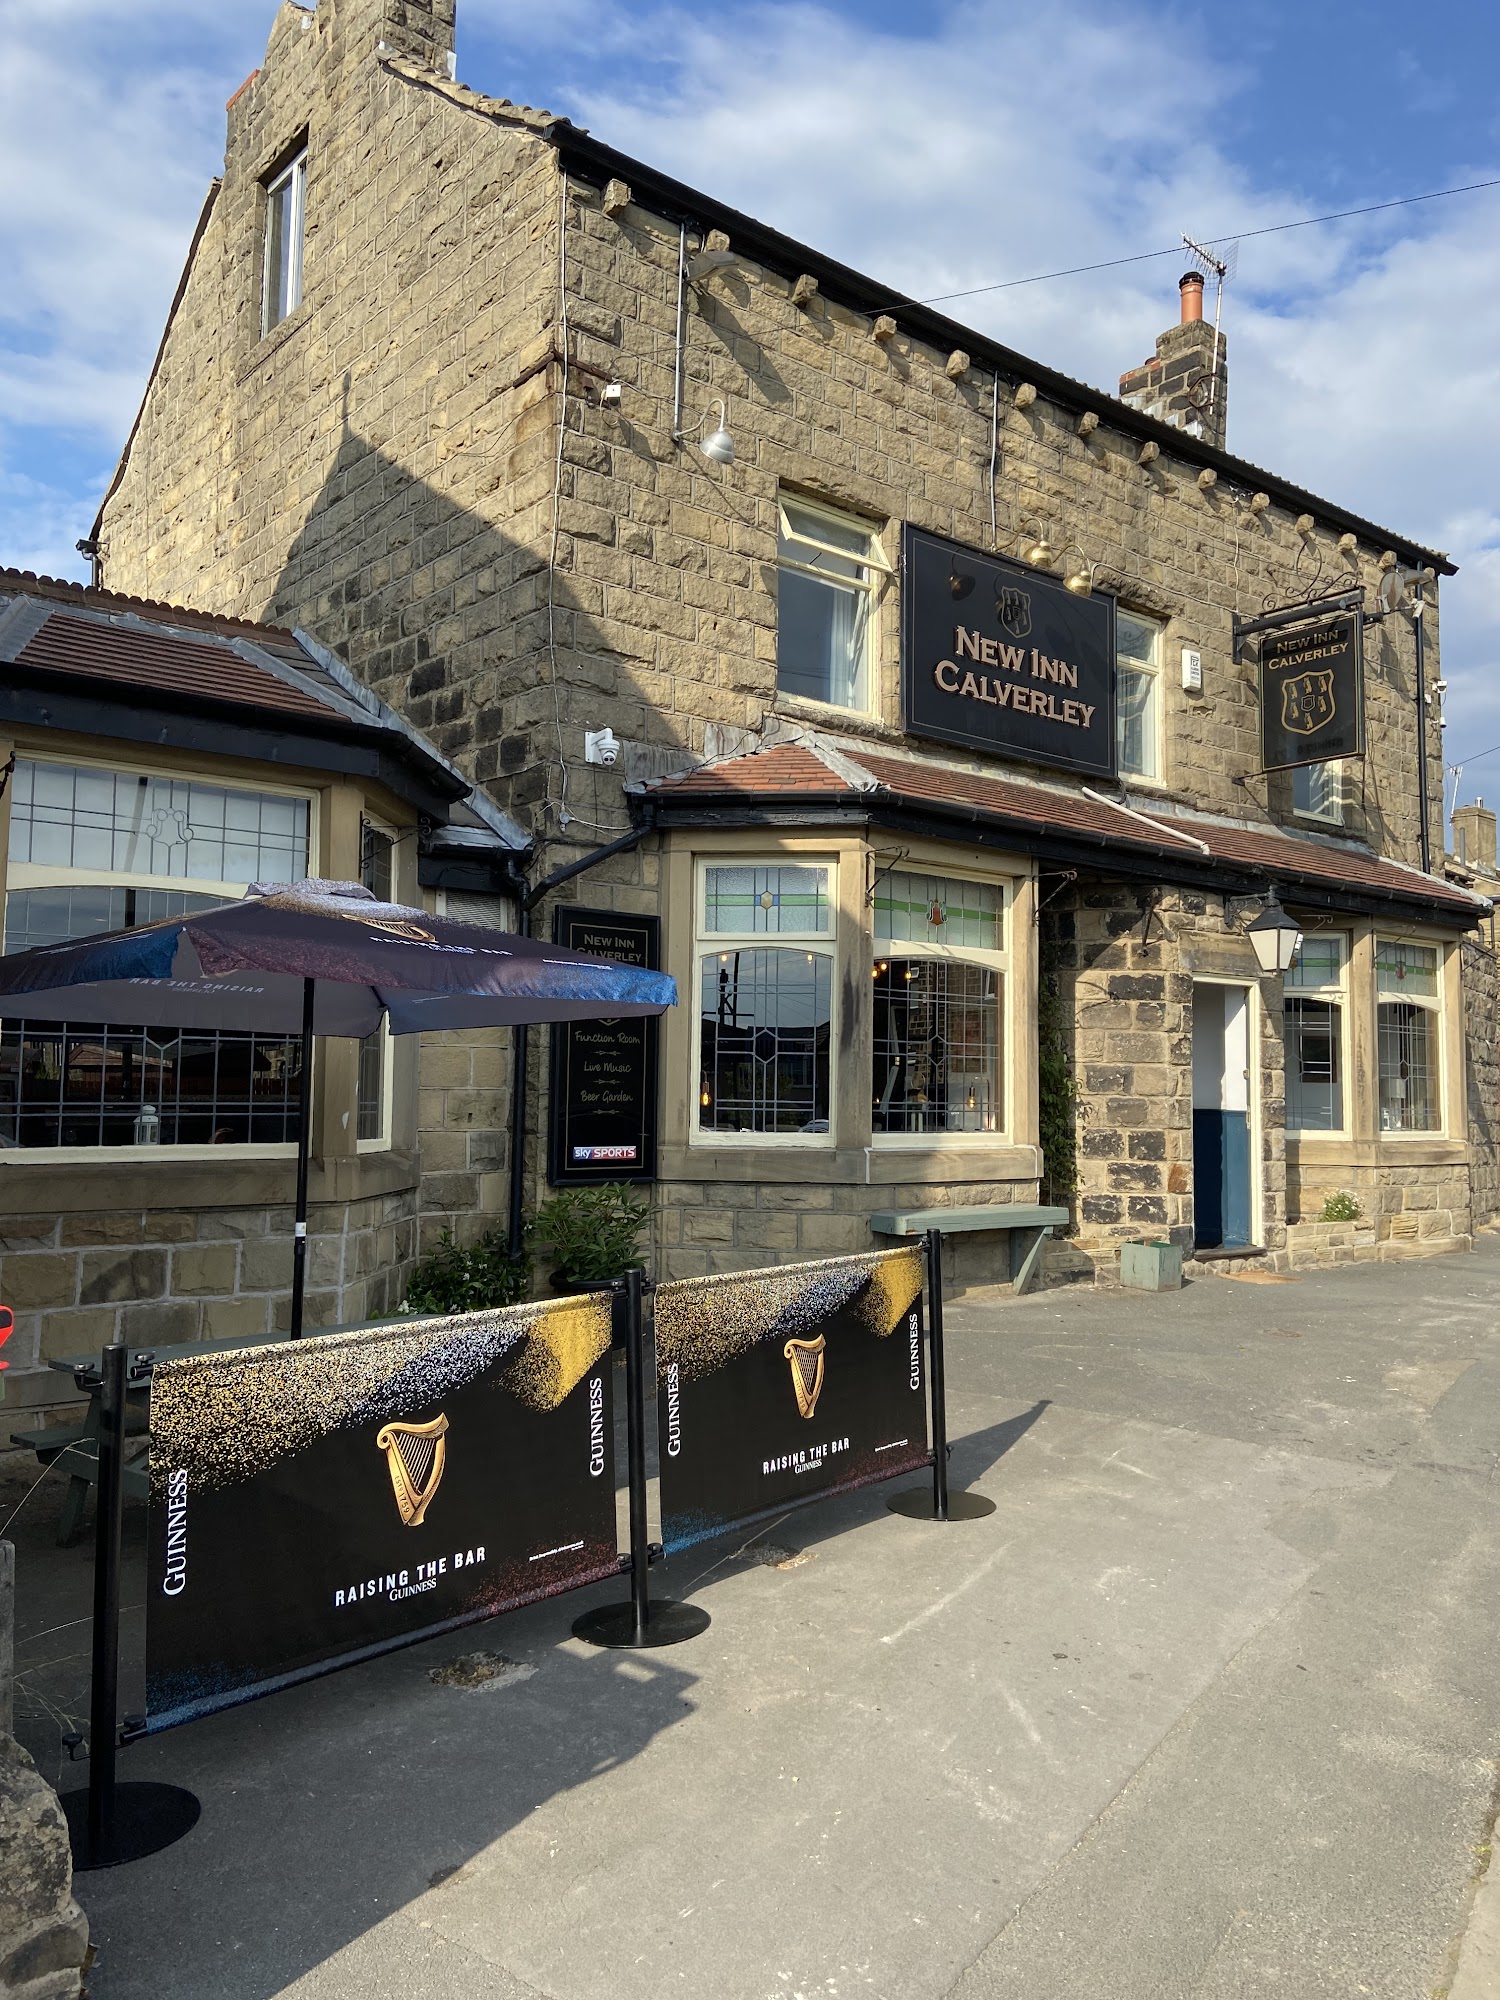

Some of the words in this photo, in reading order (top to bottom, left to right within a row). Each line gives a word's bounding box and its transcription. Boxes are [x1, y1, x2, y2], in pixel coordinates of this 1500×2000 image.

[1277, 635, 1311, 654] NEW
[1313, 629, 1339, 646] INN
[955, 625, 1025, 672] NEW
[1031, 647, 1078, 689] INN
[1268, 642, 1349, 671] CALVERLEY
[934, 659, 1096, 728] CALVERLEY
[584, 933, 612, 947] NEW
[614, 936, 635, 949] INN
[575, 1030, 615, 1043] Function
[617, 1032, 641, 1044] Room
[584, 1060, 601, 1072] Live
[603, 1062, 632, 1073] Music
[580, 1089, 600, 1102] Beer
[602, 1089, 633, 1104] Garden
[575, 1147, 591, 1159] sky
[593, 1147, 635, 1158] SPORTS
[909, 1313, 920, 1391] GUINNESS
[667, 1362, 681, 1456] GUINNESS
[589, 1377, 604, 1476] GUINNESS
[763, 1450, 806, 1475] RAISING
[809, 1444, 828, 1460] THE
[831, 1437, 850, 1454] BAR
[794, 1459, 823, 1474] GUINNESS
[162, 1469, 188, 1596] GUINNESS
[335, 1570, 409, 1607] RAISING
[417, 1557, 447, 1581] THE
[454, 1546, 485, 1569] BAR
[389, 1578, 437, 1601] GUINNESS
